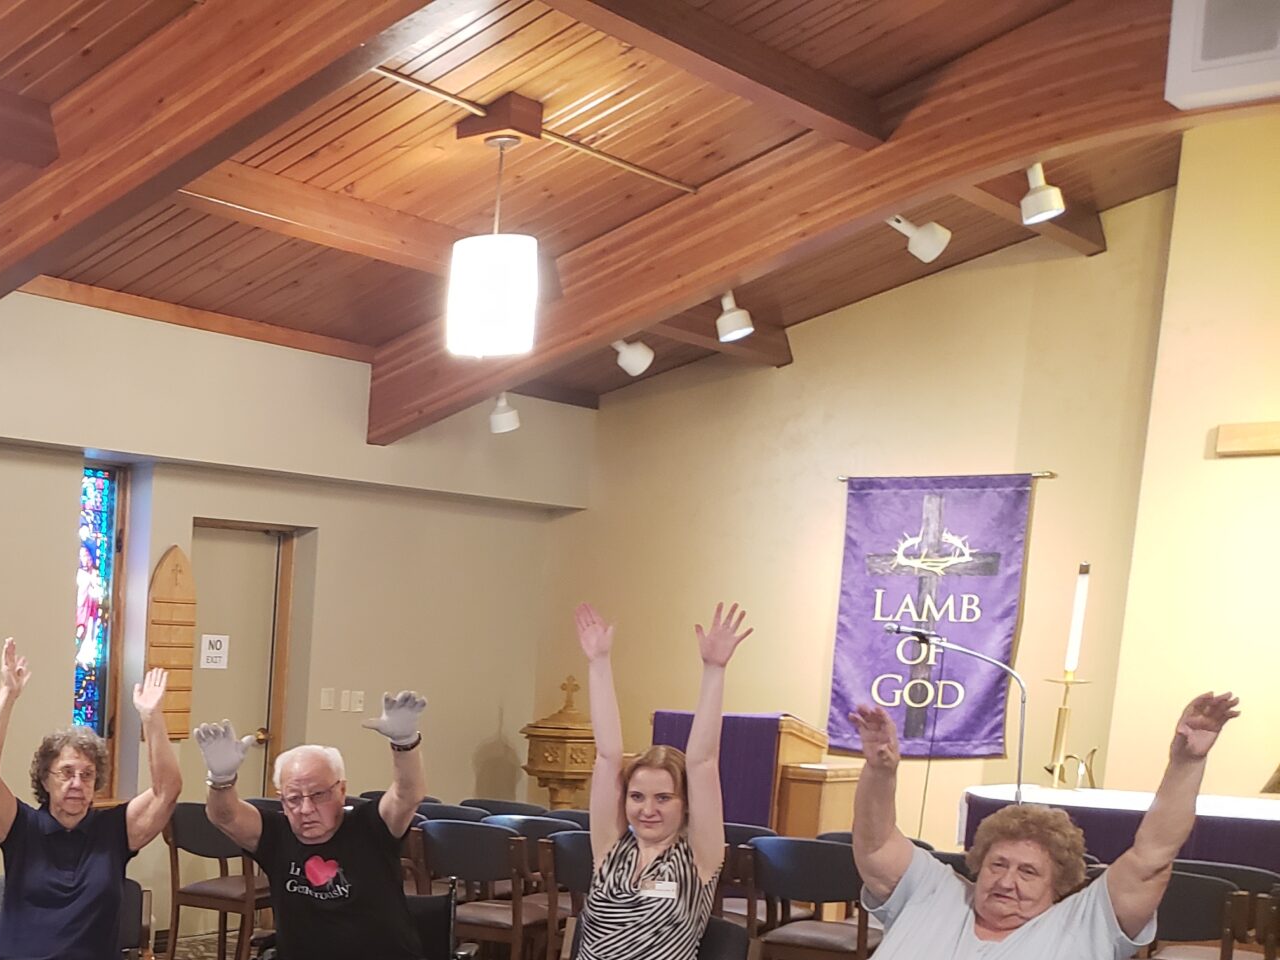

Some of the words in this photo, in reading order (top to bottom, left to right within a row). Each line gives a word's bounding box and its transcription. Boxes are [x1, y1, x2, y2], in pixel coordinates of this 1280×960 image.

[872, 589, 982, 623] LAMB
[206, 655, 223, 664] EXIT
[208, 639, 223, 651] NO
[896, 634, 948, 666] OF
[870, 673, 966, 710] GOD
